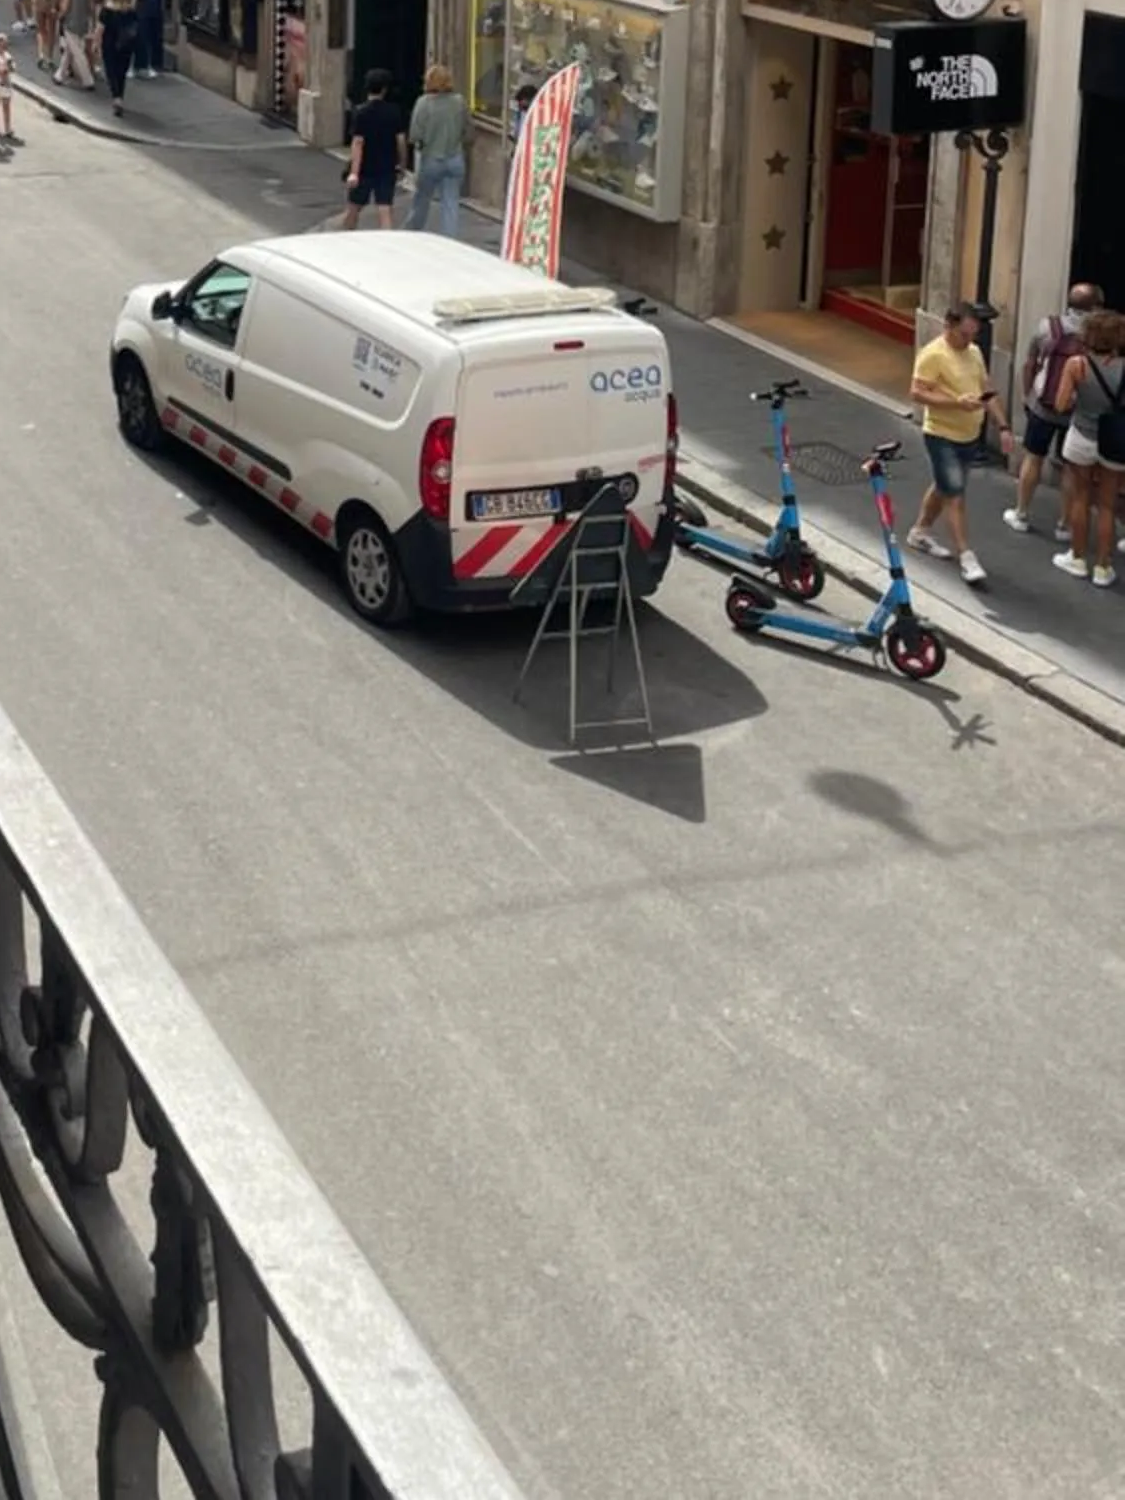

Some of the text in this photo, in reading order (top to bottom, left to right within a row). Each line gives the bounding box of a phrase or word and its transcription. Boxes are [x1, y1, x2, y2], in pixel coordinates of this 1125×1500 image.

[940, 55, 972, 70] THE
[916, 68, 972, 88] NORTH
[931, 84, 971, 100] FACE
[590, 364, 662, 393] acea
